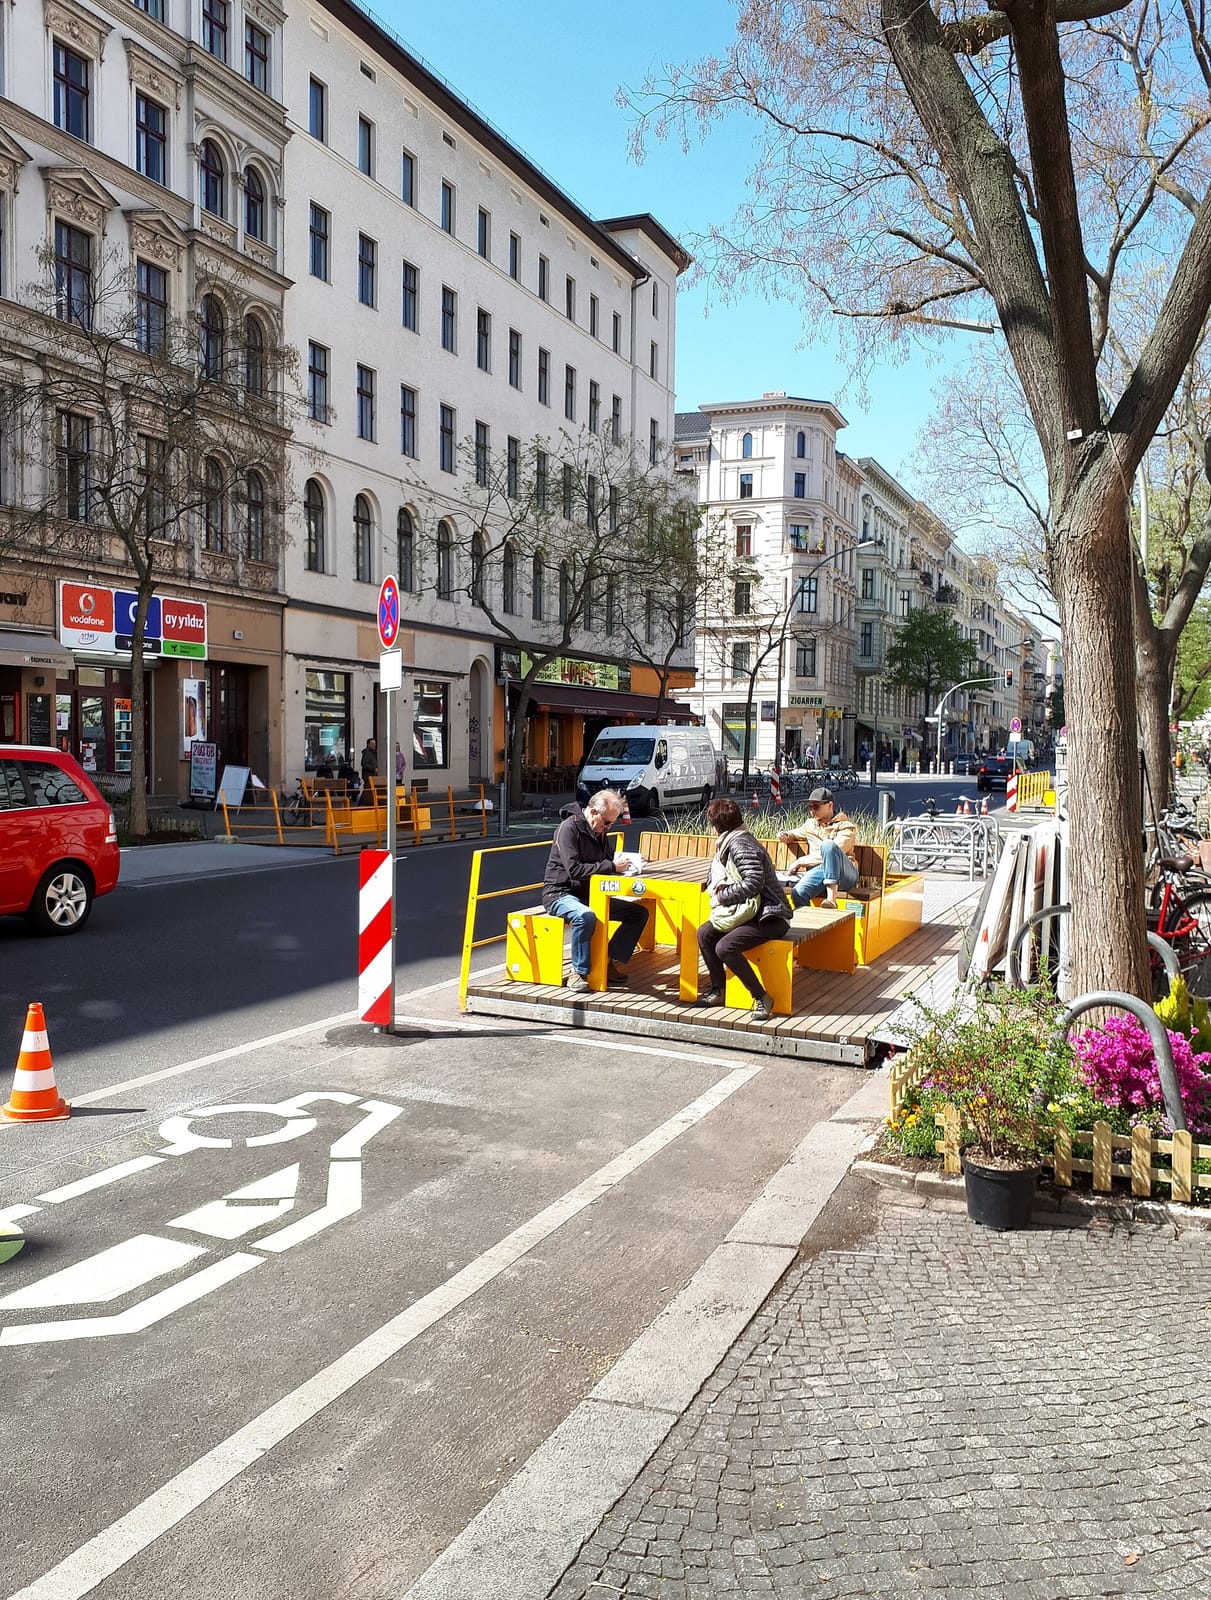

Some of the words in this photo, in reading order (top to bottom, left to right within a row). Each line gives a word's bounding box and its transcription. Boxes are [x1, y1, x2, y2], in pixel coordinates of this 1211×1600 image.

[70, 615, 105, 626] vodafone
[165, 614, 178, 628] ay
[791, 696, 823, 705] ZIGARREN
